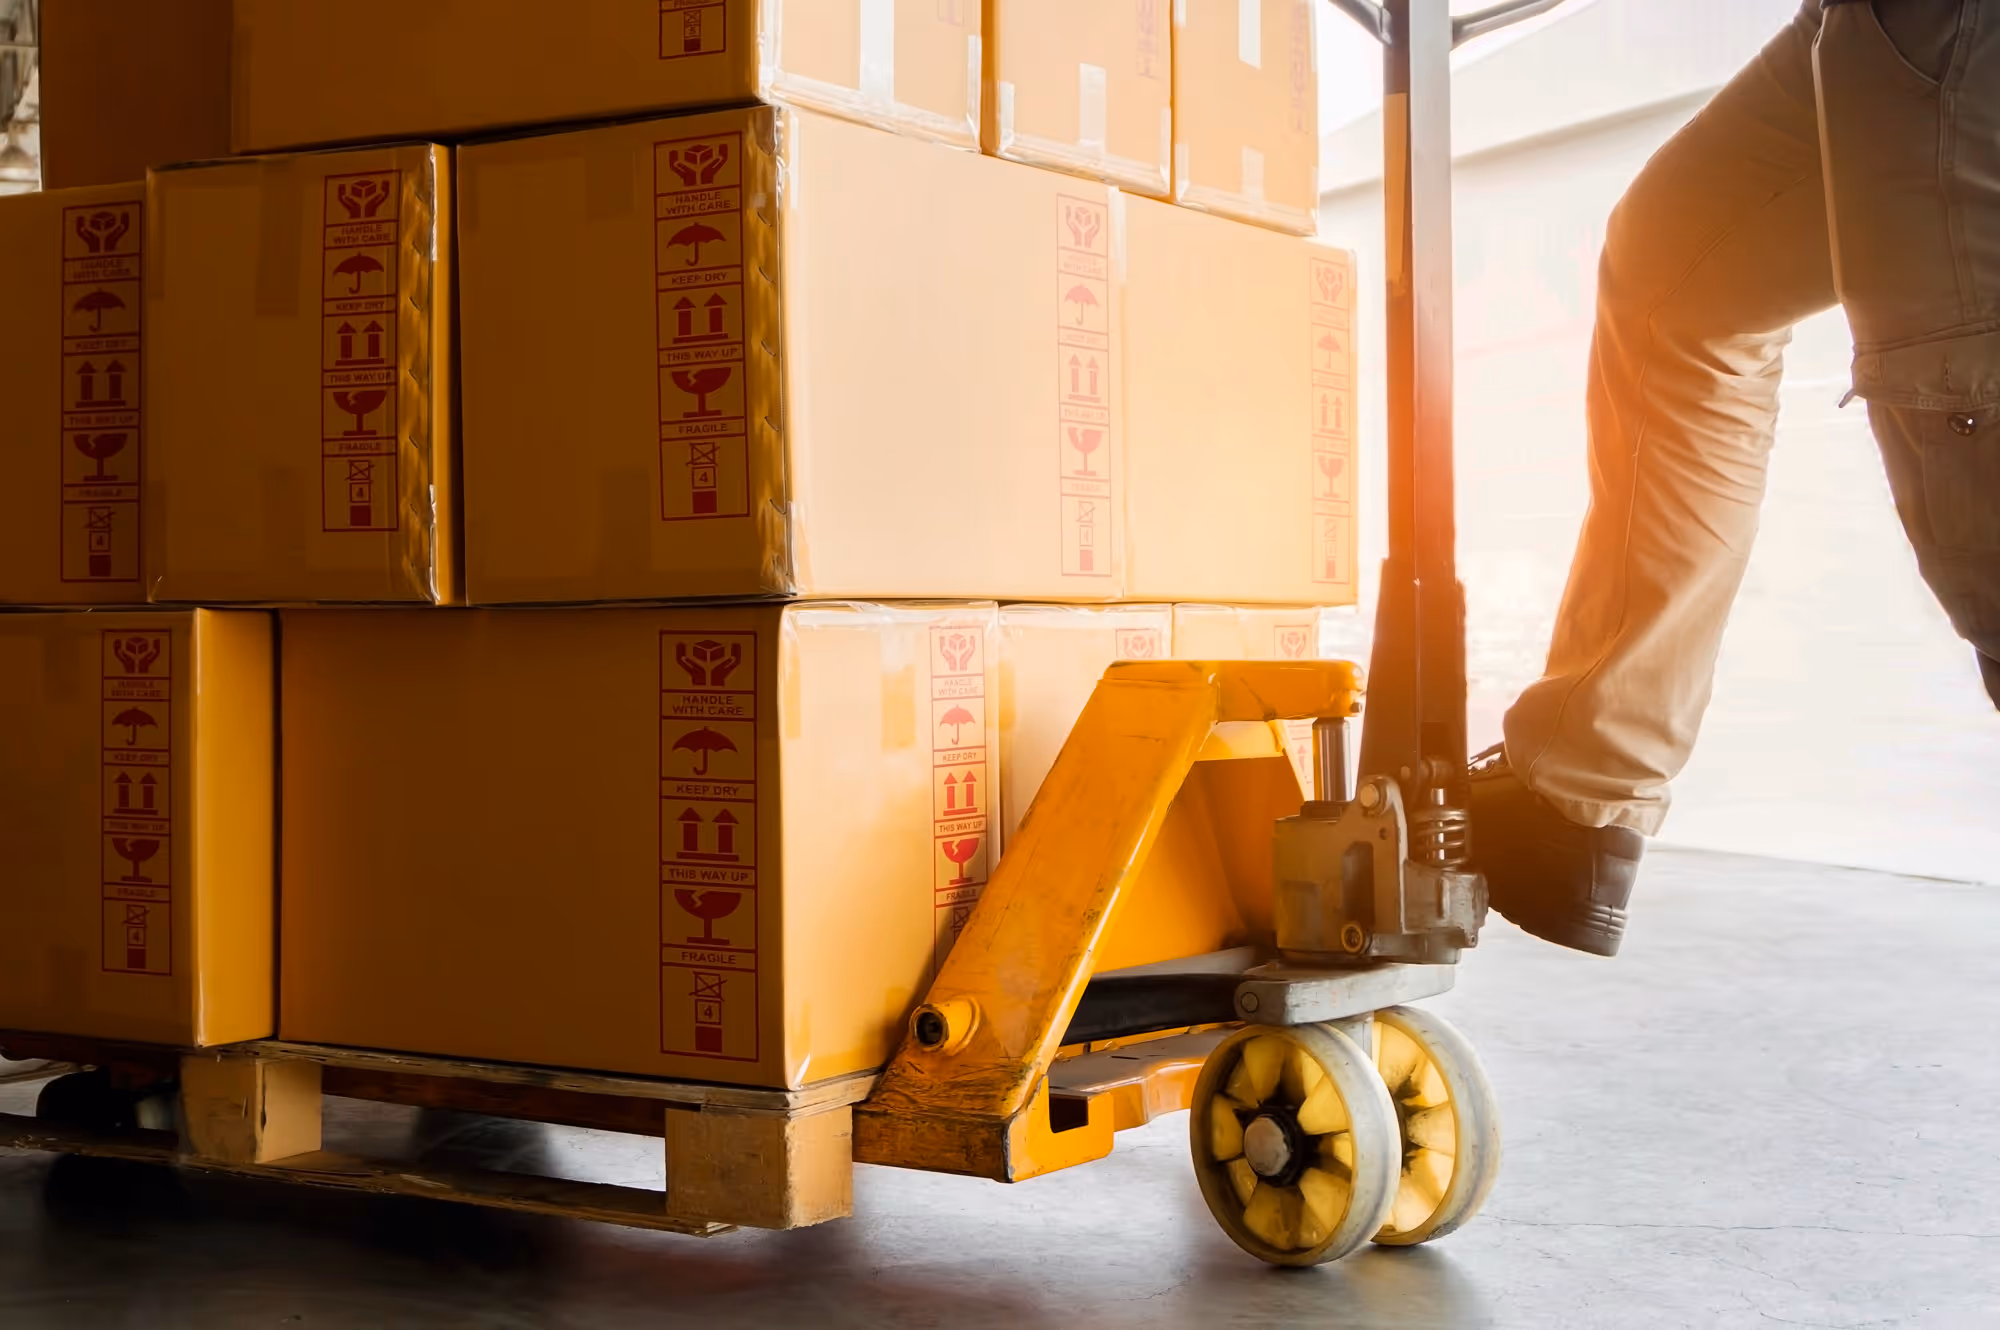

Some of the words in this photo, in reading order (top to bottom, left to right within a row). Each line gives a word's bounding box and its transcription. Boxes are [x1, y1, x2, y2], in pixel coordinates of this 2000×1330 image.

[675, 191, 721, 205] HANDLE
[666, 204, 695, 215] WITH
[699, 199, 731, 211] CARE
[671, 274, 701, 285] KEEP
[704, 271, 728, 281] DRY
[667, 353, 691, 363] THIS
[694, 350, 719, 360] WAY
[722, 348, 738, 358] UP
[678, 423, 728, 434] FRAGILE
[699, 471, 709, 482] 4
[682, 695, 734, 705] HANDLE
[672, 705, 704, 714] WITH
[708, 706, 744, 715] CARE
[676, 784, 710, 794] KEEP
[713, 786, 740, 796] DRY
[939, 823, 955, 833] THIS
[957, 822, 972, 831] WAY
[973, 820, 983, 829] UP
[669, 869, 696, 879] THIS
[700, 870, 727, 881] WAY
[731, 872, 748, 882] UP
[681, 951, 736, 965] FRAGILE
[704, 1006, 713, 1019] 4
